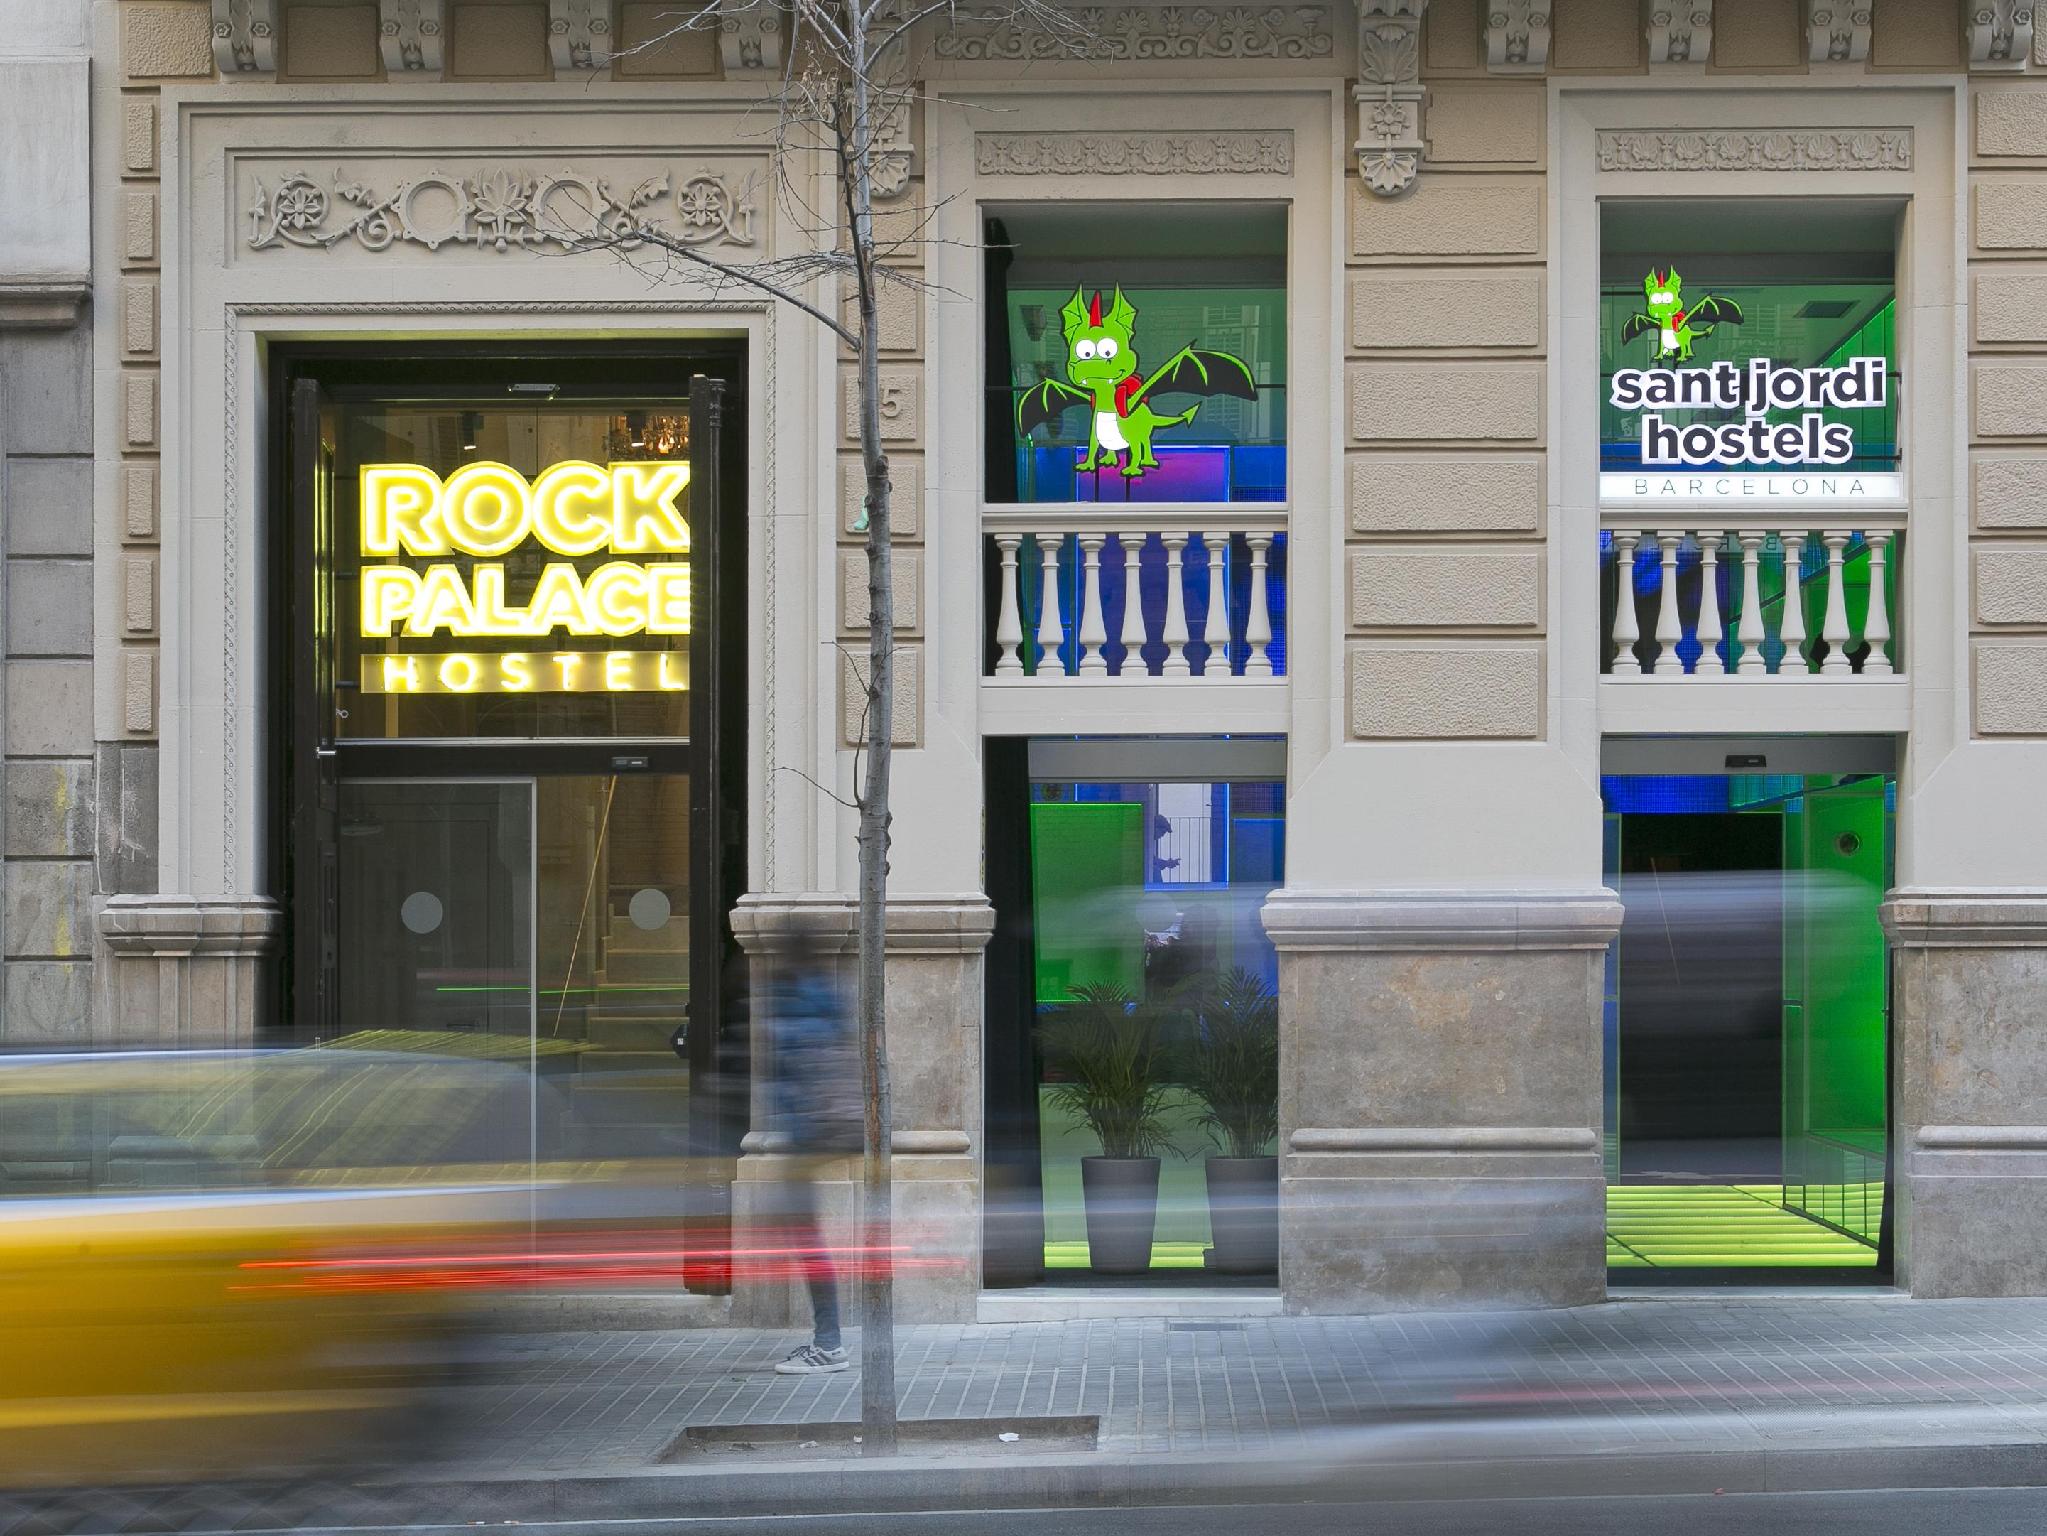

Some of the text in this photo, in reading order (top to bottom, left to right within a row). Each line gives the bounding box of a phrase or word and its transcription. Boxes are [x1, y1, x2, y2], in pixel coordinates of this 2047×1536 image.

[1615, 360, 1883, 413] sant jordi
[1647, 416, 1851, 460] hostels
[360, 460, 691, 556] ROCK
[1634, 478, 1865, 495] BARCELONA
[360, 562, 691, 637] PALACE
[382, 654, 689, 692] HOSTEL
